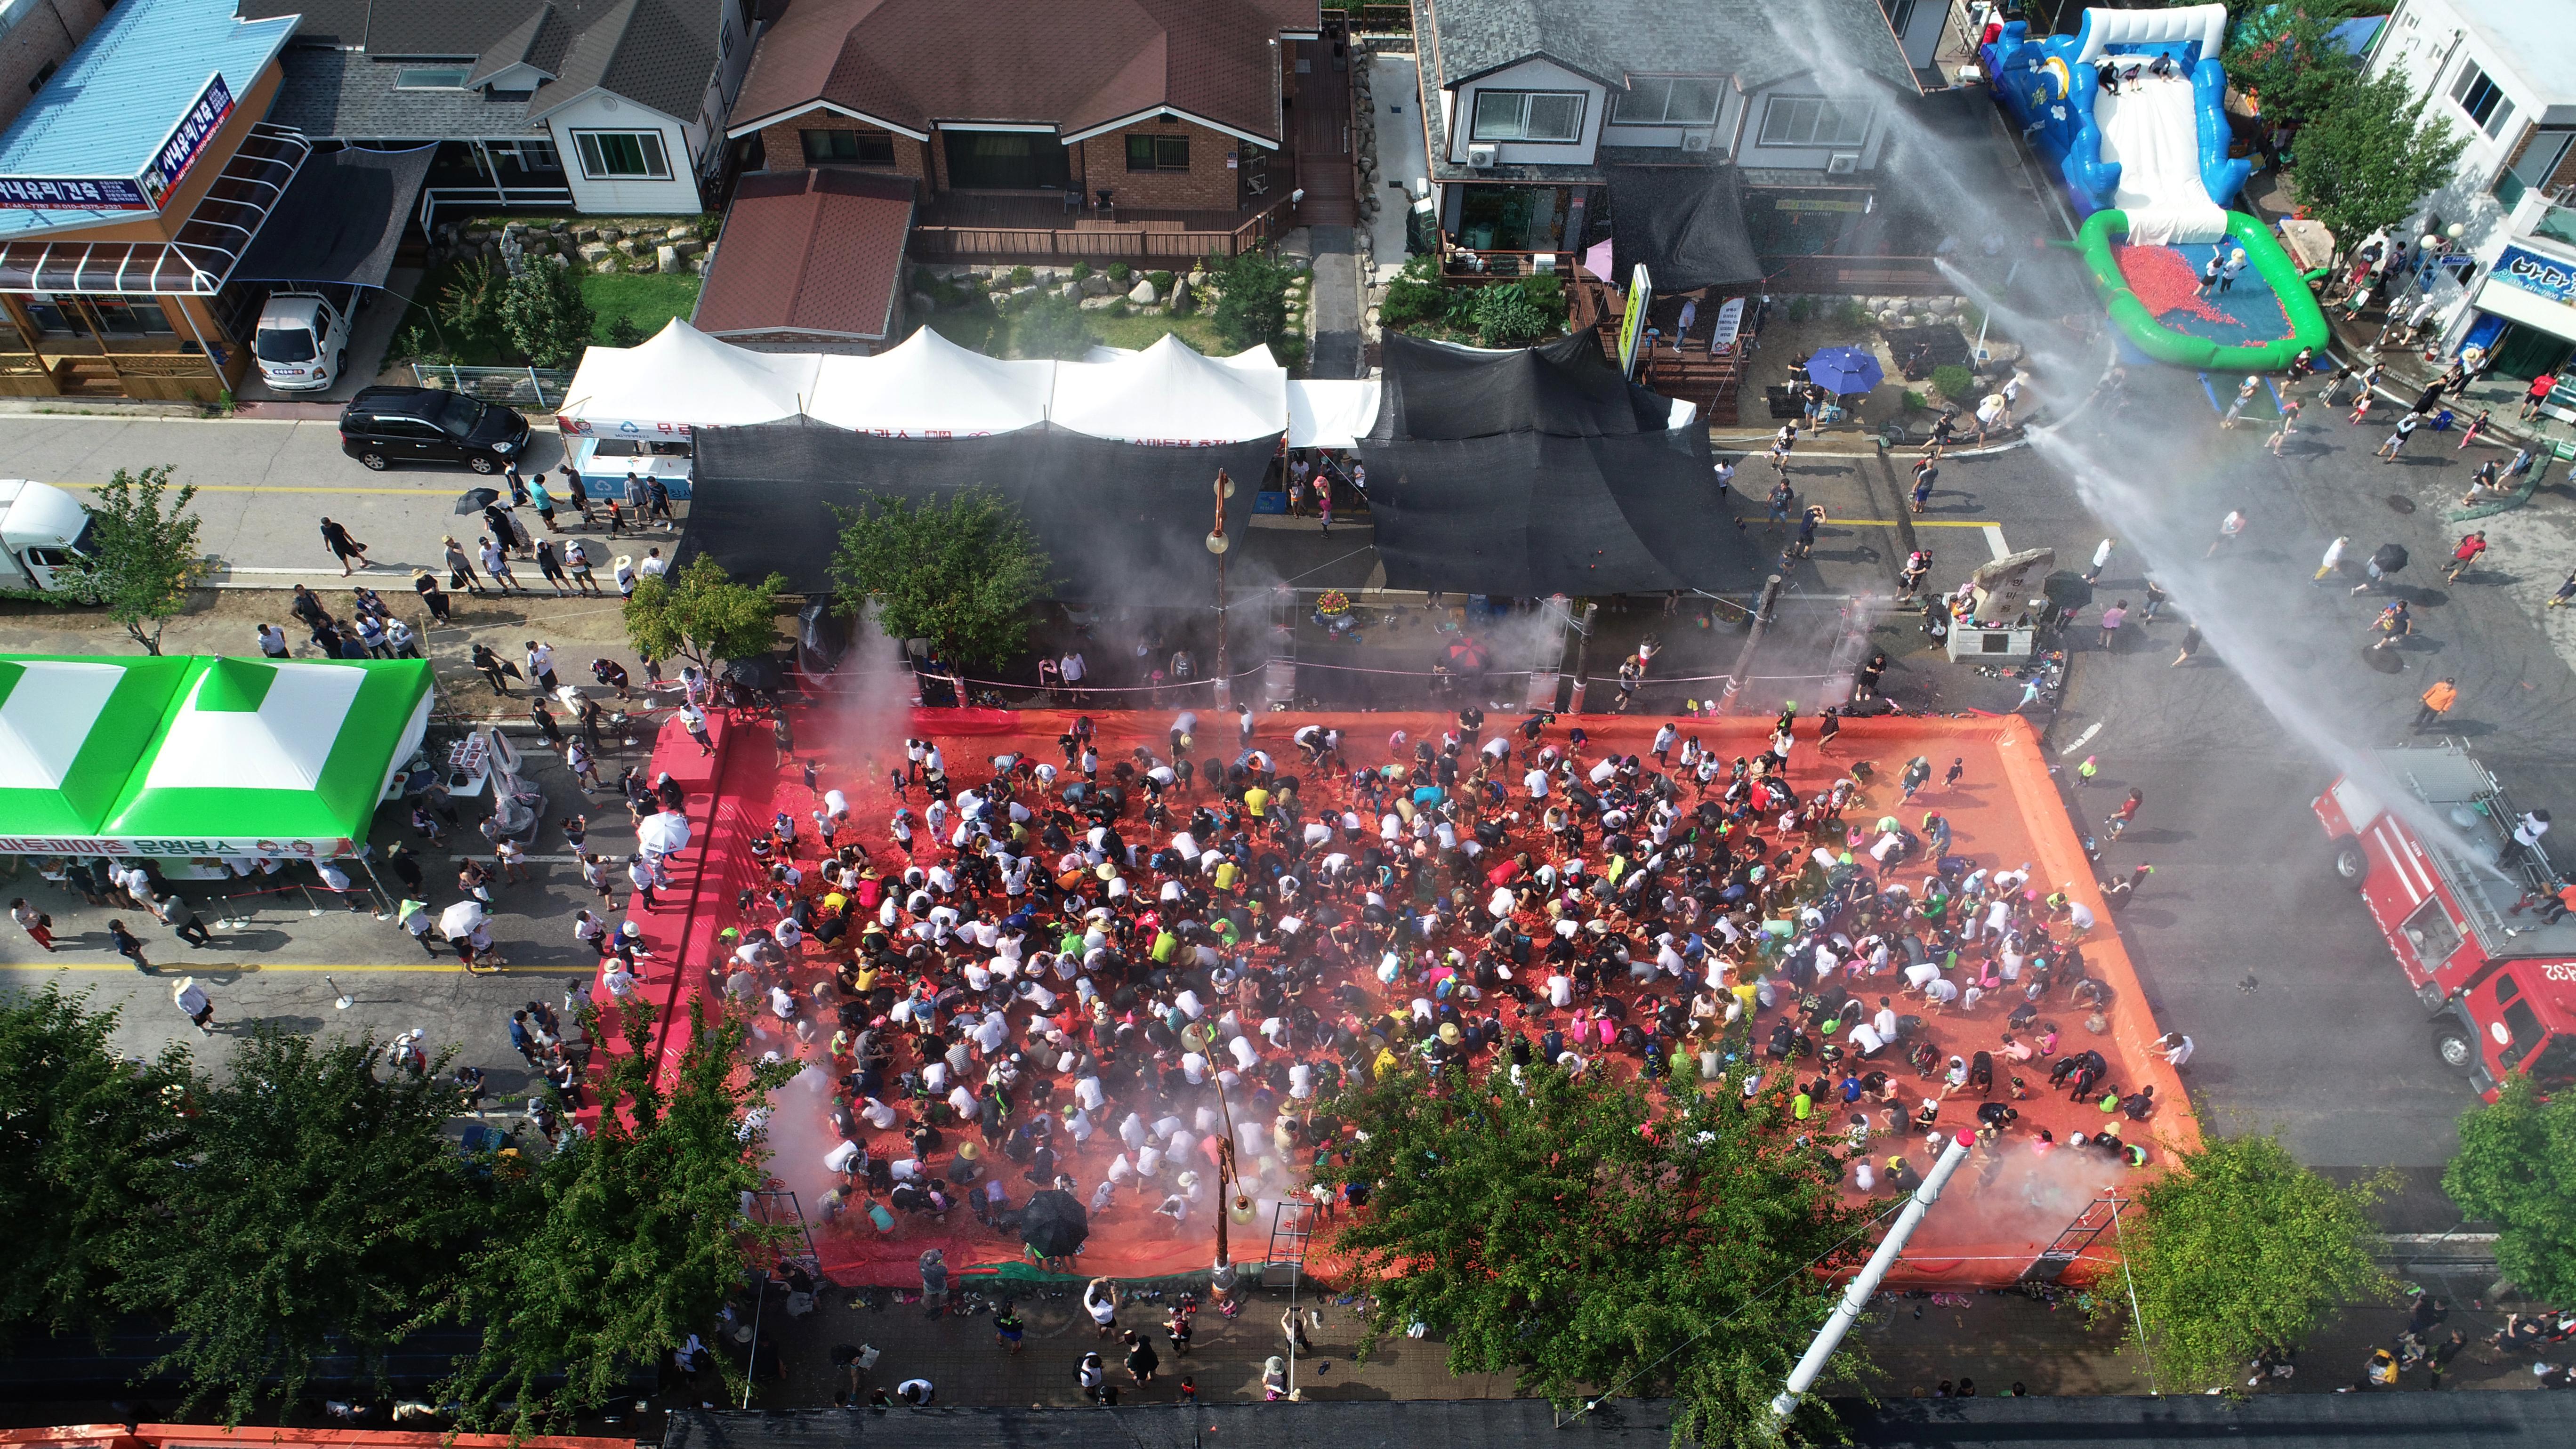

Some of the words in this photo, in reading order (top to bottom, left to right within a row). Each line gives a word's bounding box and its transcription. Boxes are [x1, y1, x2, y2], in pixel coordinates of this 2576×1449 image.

[162, 99, 214, 171] 사내유리/건축
[657, 423, 691, 435] 무료
[134, 840, 242, 855] 운영부스
[1145, 912, 1154, 923] 12
